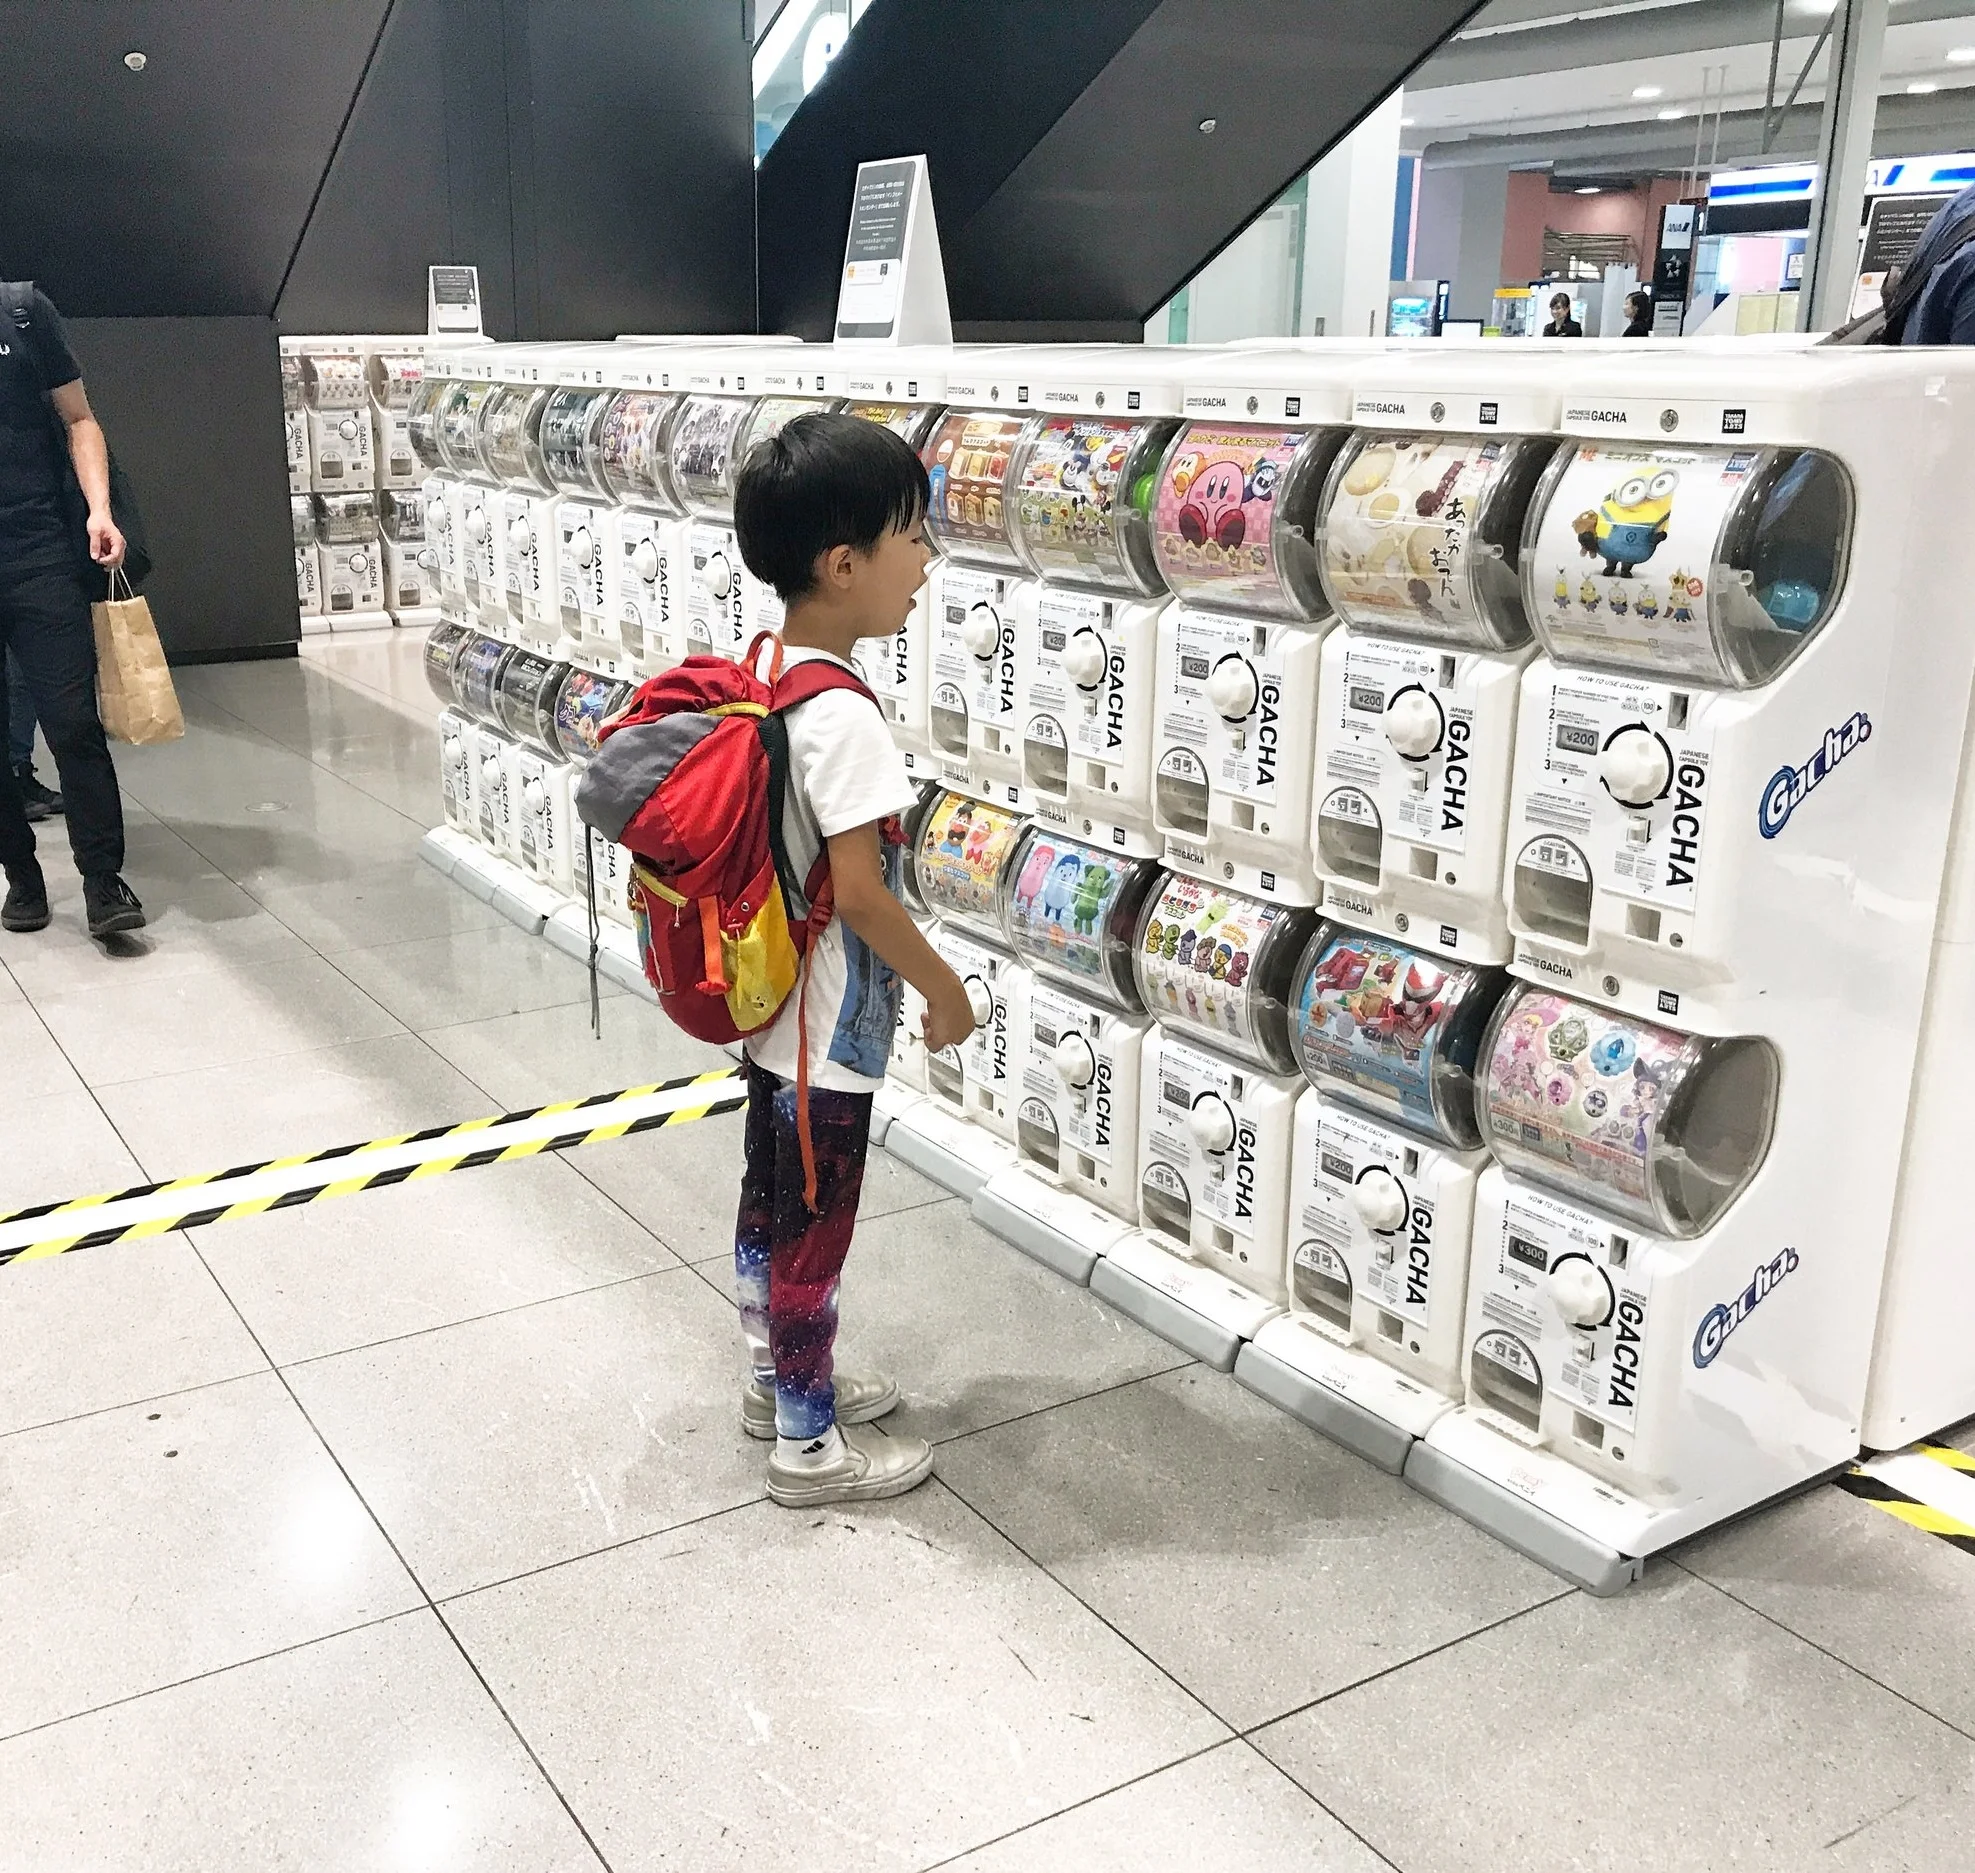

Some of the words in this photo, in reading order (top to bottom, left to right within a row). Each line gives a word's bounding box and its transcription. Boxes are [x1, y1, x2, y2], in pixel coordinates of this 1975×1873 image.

[1059, 393, 1078, 402] GACHA
[1202, 397, 1227, 407] GACHA
[1376, 403, 1405, 414] GACHA
[1591, 410, 1627, 423] GACHA
[359, 427, 368, 457] GACHA
[486, 521, 495, 577] GACHA
[531, 532, 540, 591] GACHA
[305, 563, 315, 593] GACHA
[368, 559, 378, 589] GACHA
[594, 543, 604, 606] GACHA
[659, 556, 670, 623] GACHA
[732, 572, 743, 642] GACHA
[1000, 628, 1015, 713] GACHA
[1189, 663, 1208, 674] ¥200
[1106, 655, 1125, 748] GACHA
[1359, 694, 1381, 707] ¥200
[1449, 707, 1473, 716] JAPANESE
[1256, 685, 1280, 786] GACHA
[1567, 732, 1595, 747] ¥200
[1678, 756, 1699, 764] CAPSULE
[1679, 749, 1709, 759] JAPANESE
[462, 751, 470, 801] GACHA
[1441, 720, 1470, 831] GACHA
[500, 772, 509, 824] GACHA
[545, 795, 554, 850] GACHA
[1047, 811, 1067, 824] GACHA
[1666, 764, 1705, 887] GACHA
[607, 843, 616, 879] CHA
[1181, 850, 1204, 865] GACHA
[1345, 900, 1373, 916] GACHA
[1540, 960, 1573, 979] GACHA
[993, 1004, 1007, 1080] GACHA
[1096, 1063, 1112, 1146] GACHA
[1235, 1128, 1256, 1216] GACHA
[1405, 1208, 1432, 1304] GACHA
[1518, 1242, 1544, 1261] ¥300
[1620, 1287, 1647, 1302] JAPANESE
[1607, 1302, 1643, 1407] GACHA
